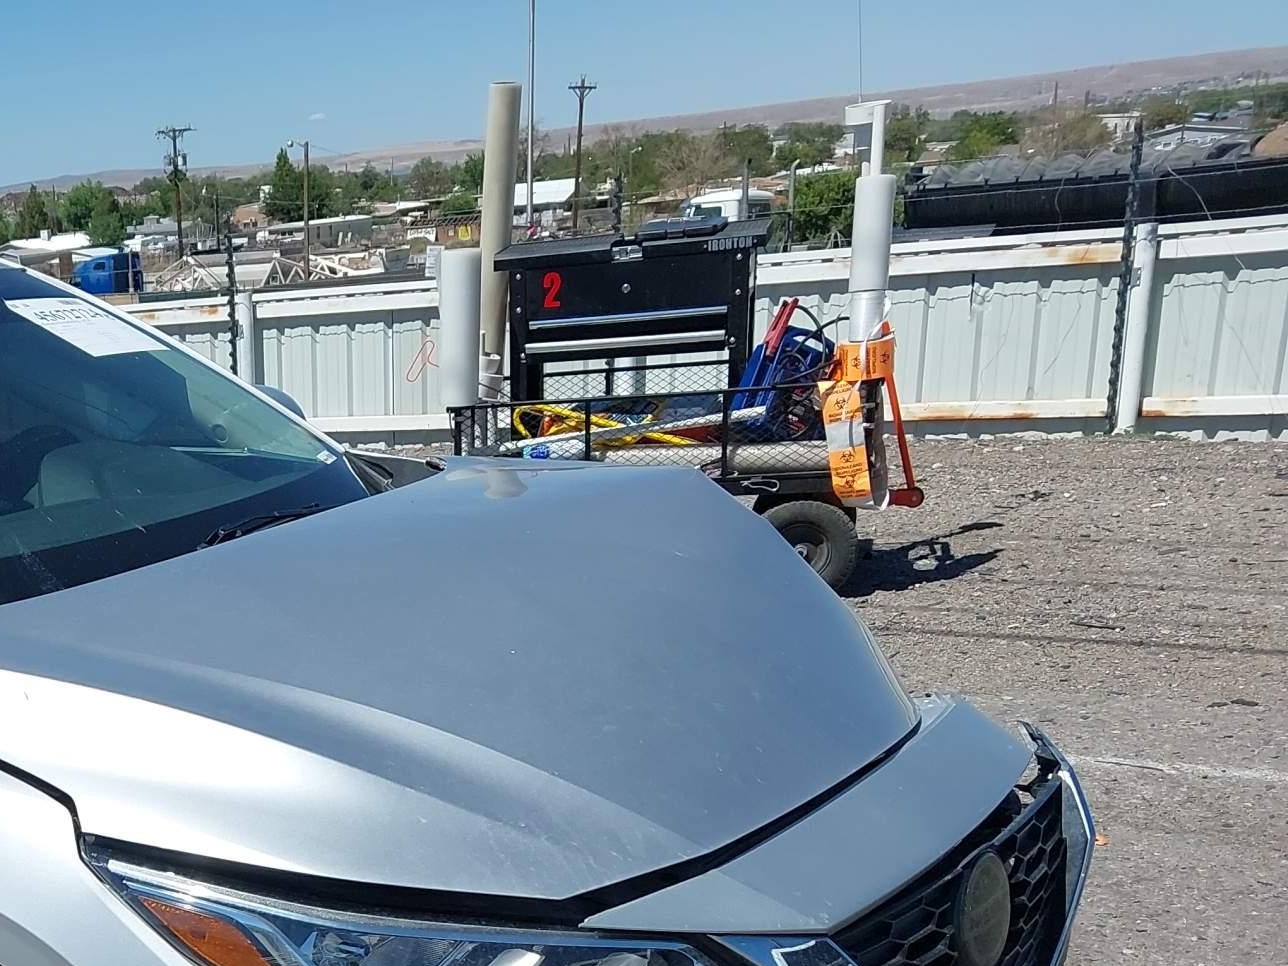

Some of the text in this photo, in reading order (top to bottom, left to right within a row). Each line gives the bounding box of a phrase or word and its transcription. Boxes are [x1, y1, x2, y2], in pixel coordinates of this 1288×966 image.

[708, 236, 753, 252] IRONTON
[543, 272, 562, 309] 2
[33, 308, 104, 322] 45672724
